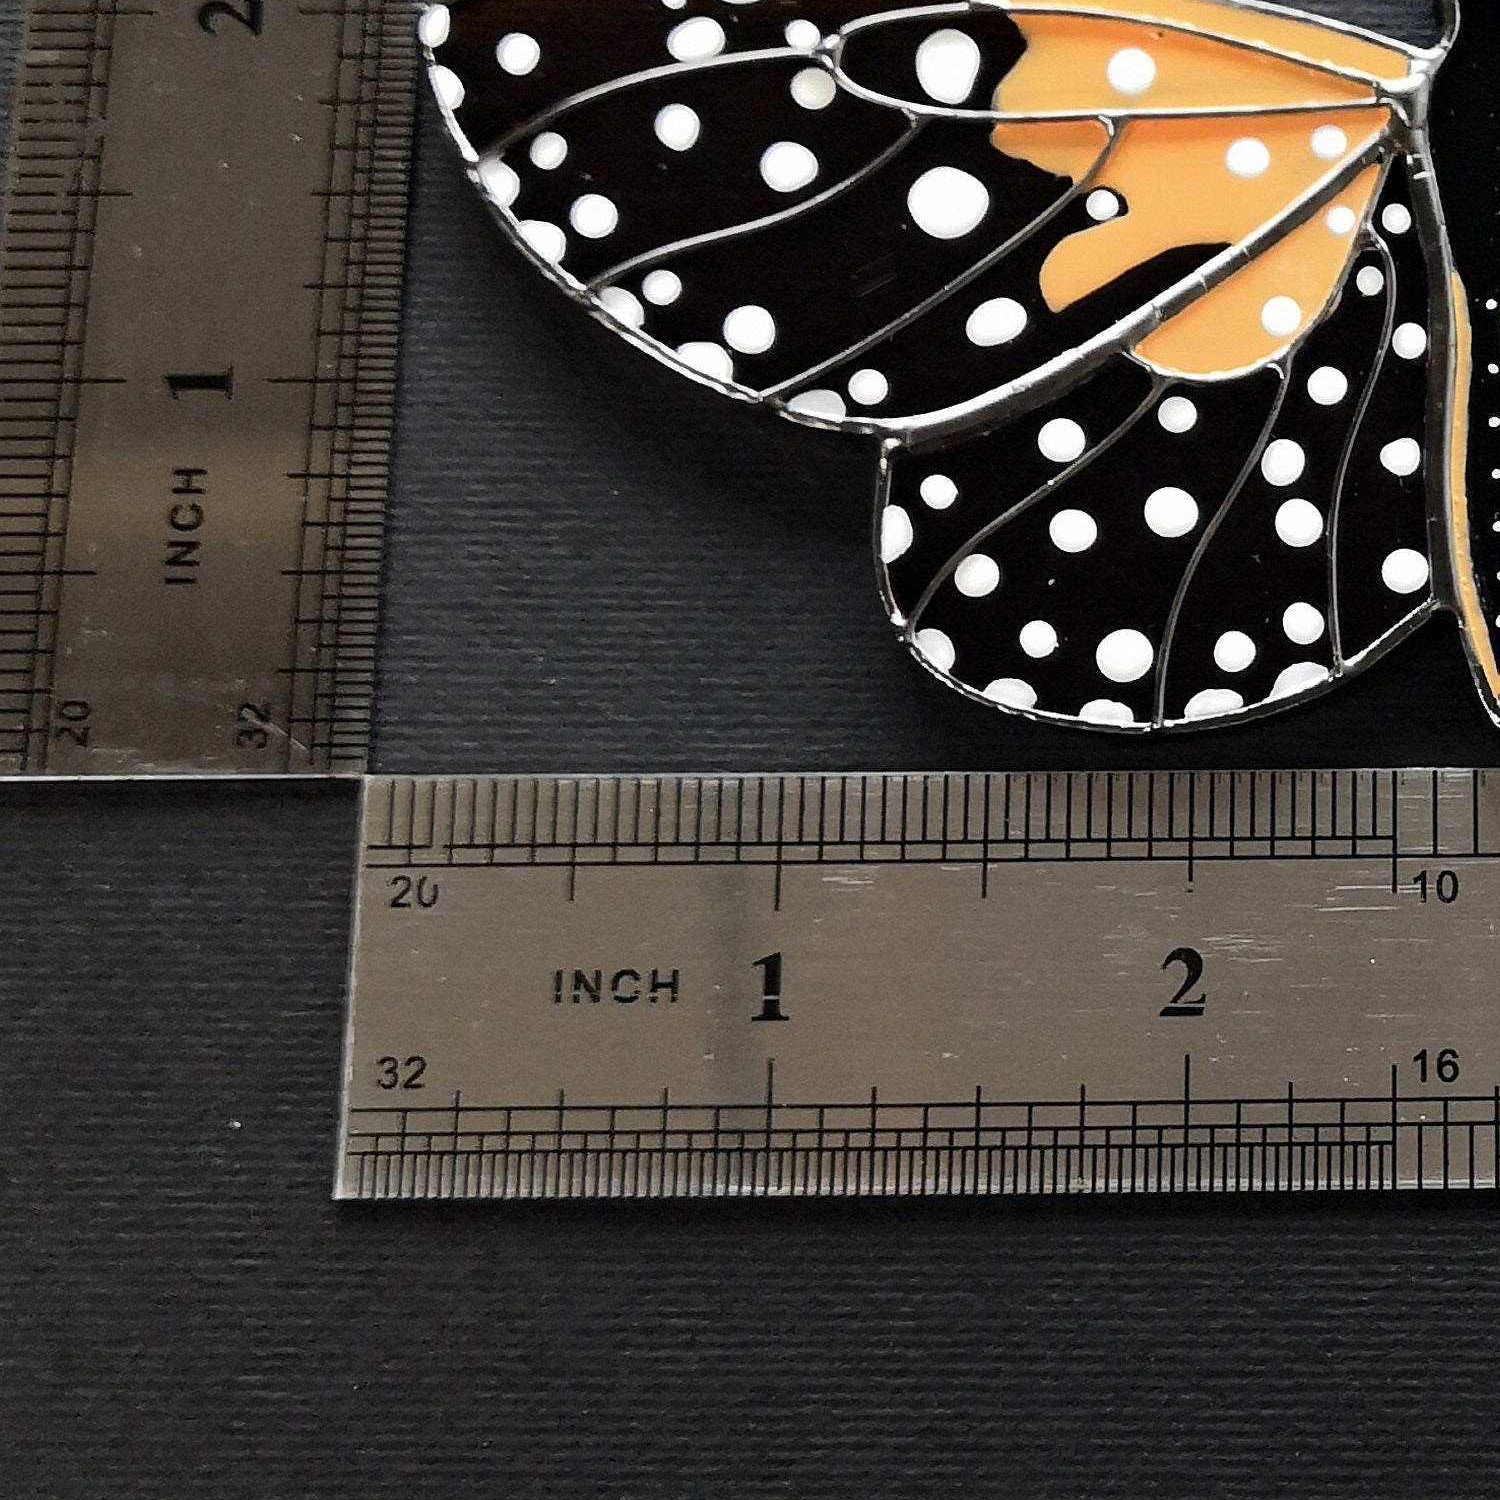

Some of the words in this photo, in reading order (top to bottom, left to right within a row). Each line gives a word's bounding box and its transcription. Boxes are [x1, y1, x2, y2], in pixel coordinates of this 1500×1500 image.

[162, 364, 235, 402] 1
[164, 466, 208, 586] INCH
[55, 700, 90, 747] 20
[234, 702, 271, 749] 32
[388, 874, 440, 908] 20
[1412, 869, 1460, 904] 10
[551, 967, 680, 1004] INCH
[750, 951, 790, 1022] 1
[1159, 946, 1207, 1017] 2
[376, 1055, 428, 1090] 32
[1412, 1048, 1461, 1083] 16
